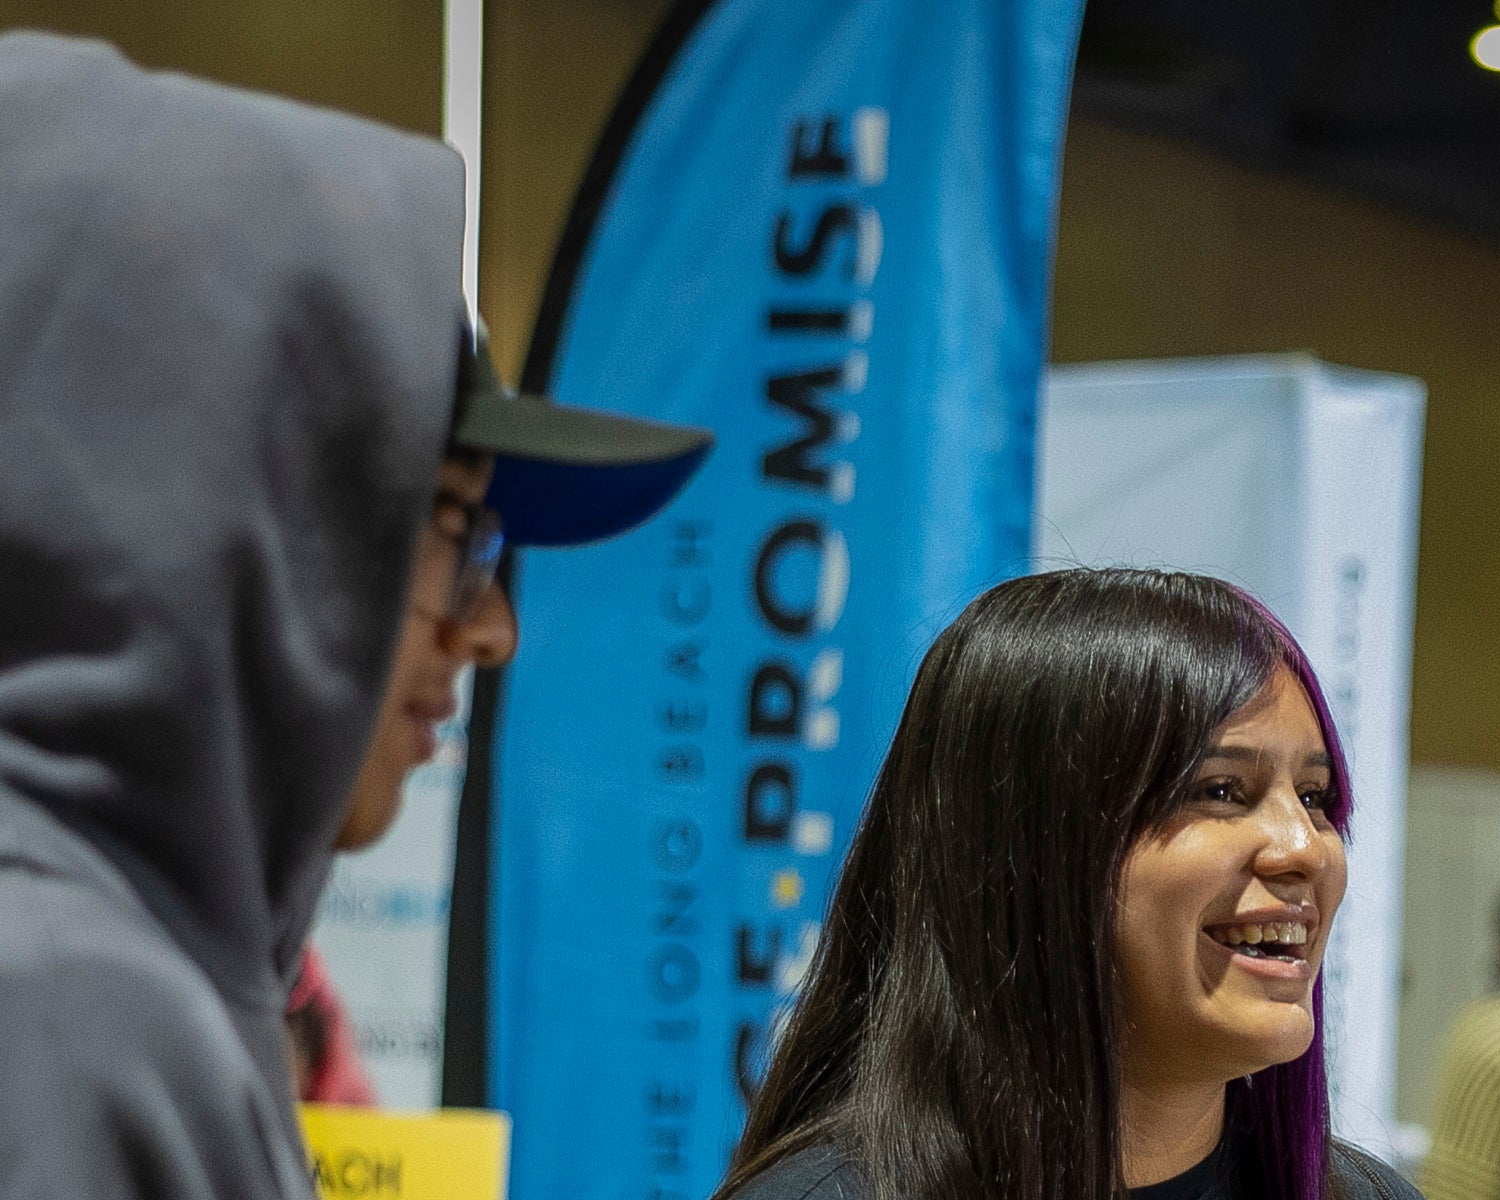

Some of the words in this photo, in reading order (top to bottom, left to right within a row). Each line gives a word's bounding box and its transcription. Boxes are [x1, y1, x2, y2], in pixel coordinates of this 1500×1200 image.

[744, 107, 890, 856] PROMISE
[657, 521, 714, 783] BEACH
[654, 814, 703, 1042] LONG
[312, 1153, 402, 1193] ACH
